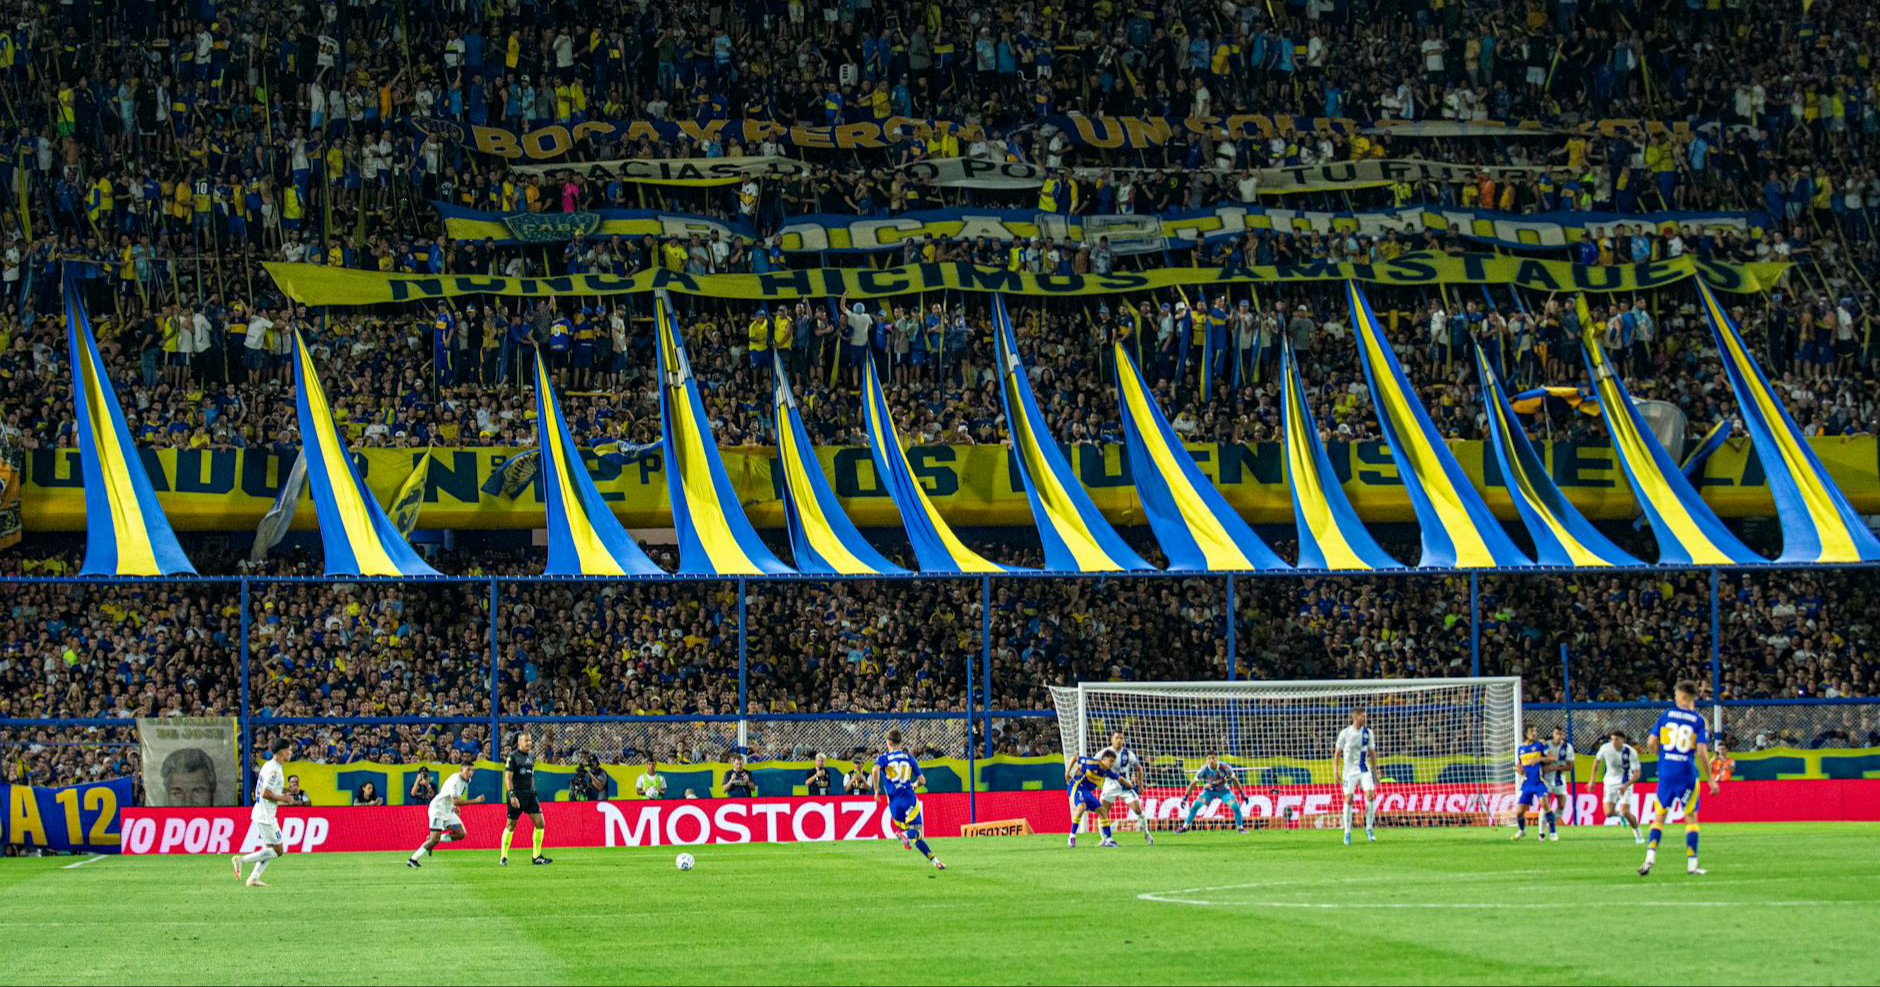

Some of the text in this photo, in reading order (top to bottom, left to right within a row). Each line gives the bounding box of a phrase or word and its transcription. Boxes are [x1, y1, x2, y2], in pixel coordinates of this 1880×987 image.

[471, 119, 661, 160] BOCA
[1070, 114, 1172, 150] UN
[194, 181, 209, 195] 10
[1280, 163, 1358, 184] TU
[658, 214, 1018, 252] BOCA
[389, 252, 1742, 299] NUNCA HICIMOS AMISTADES
[1662, 721, 1694, 754] 38
[886, 760, 912, 784] 30
[9, 784, 121, 846] A 12
[1239, 794, 1332, 821] OFF
[1528, 793, 1598, 826] OR
[159, 817, 235, 854] POR
[239, 817, 330, 853] APP
